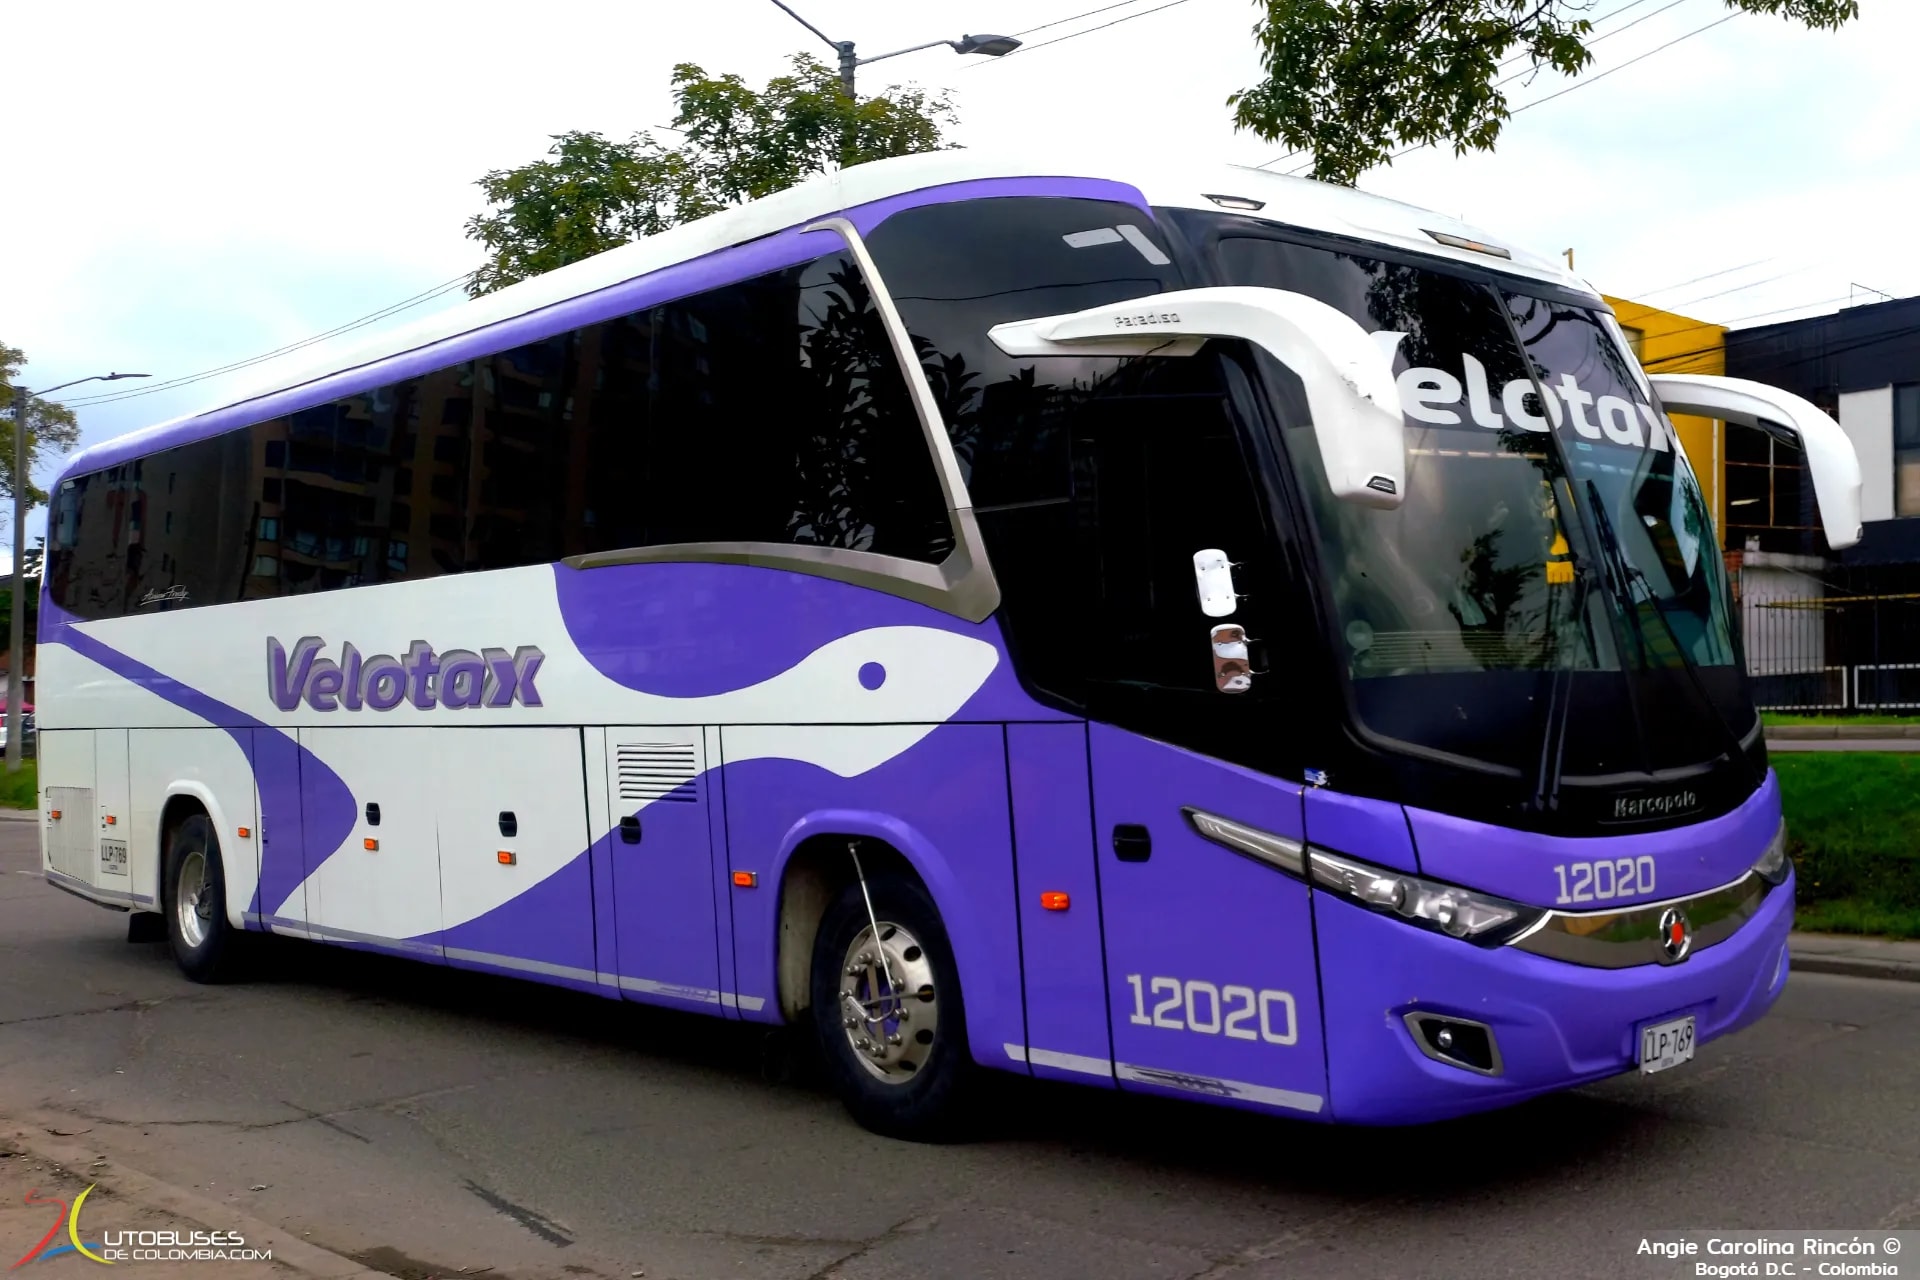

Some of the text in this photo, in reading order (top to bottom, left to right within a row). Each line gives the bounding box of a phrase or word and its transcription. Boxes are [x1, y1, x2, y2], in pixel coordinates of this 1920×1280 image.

[1114, 311, 1181, 328] Paradiso
[266, 635, 546, 712] Velotax
[1615, 790, 1696, 817] Marcopolo
[1553, 855, 1656, 904] 12020
[1127, 974, 1297, 1046] 12020
